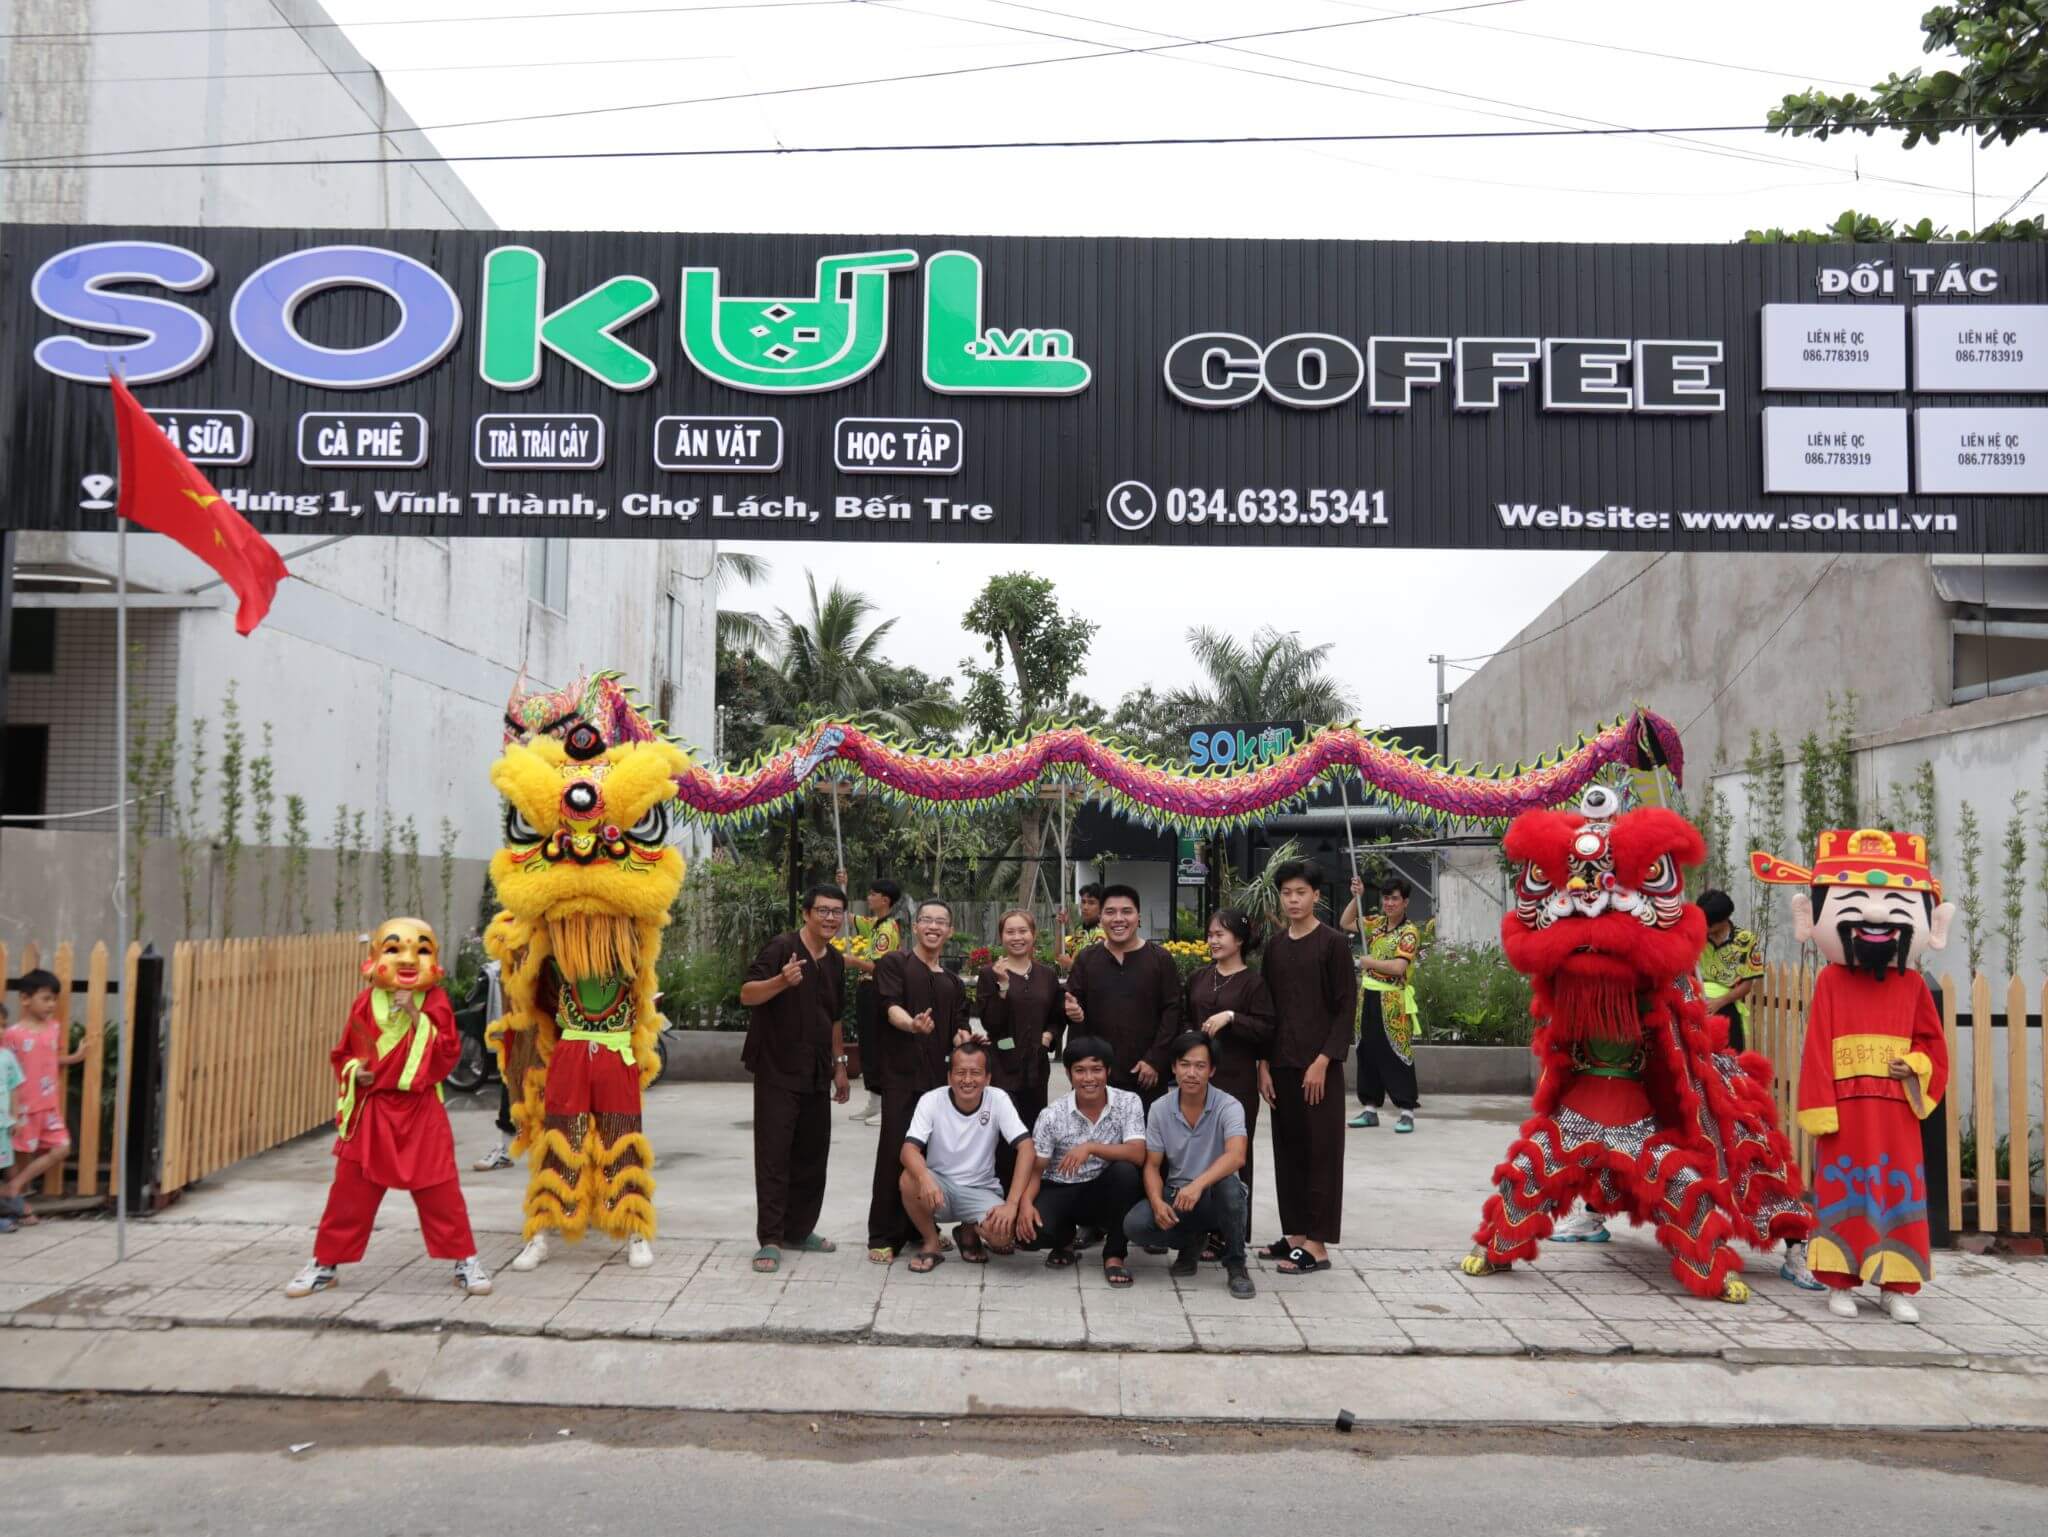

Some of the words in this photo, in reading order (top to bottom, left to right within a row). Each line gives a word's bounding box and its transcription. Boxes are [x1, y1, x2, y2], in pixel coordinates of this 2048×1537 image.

[1820, 260, 1895, 293] ĐỐI
[1909, 262, 1998, 293] TÁC
[1807, 328, 1830, 344] LIÊN
[1833, 330, 1847, 348] HỆ
[1850, 331, 1864, 345] QC
[1958, 329, 1982, 345] LIÊN
[1985, 330, 1999, 349] HỆ
[2002, 332, 2017, 346] QC
[1803, 349, 1869, 362] 086.7783919
[1955, 349, 2023, 362] 086.7783919
[1163, 331, 1727, 412] COFFEE
[187, 419, 235, 454] SỮA
[318, 421, 349, 456] CÀ
[357, 422, 404, 456] PHÊ
[489, 423, 518, 457] TRÀ
[522, 423, 556, 457] TRÁI
[559, 423, 589, 458] CÂY
[675, 423, 708, 457] ĂN
[715, 424, 761, 465] VẶT
[848, 432, 896, 465] HỌC
[903, 426, 950, 466] TẬP
[1807, 432, 1831, 447] LIÊN
[1834, 434, 1848, 452] HỆ
[1851, 435, 1865, 447] QC
[1960, 433, 1984, 447] LIÊN
[1987, 434, 2001, 453] HỆ
[2004, 435, 2019, 448] QC
[1804, 453, 1871, 465] 086.7783919
[1958, 453, 2025, 466] 086.7783919
[329, 491, 362, 516] 1,
[374, 490, 460, 515] Vĩnh
[471, 492, 608, 520] Thành,
[621, 493, 700, 521] Chợ
[712, 495, 820, 521] Lách,
[835, 494, 912, 520] Bến
[923, 498, 994, 521] Tre
[1166, 487, 1388, 528] 034.633.5341
[1498, 503, 1670, 531] Website:
[1682, 508, 1958, 532] www.sokul.vn
